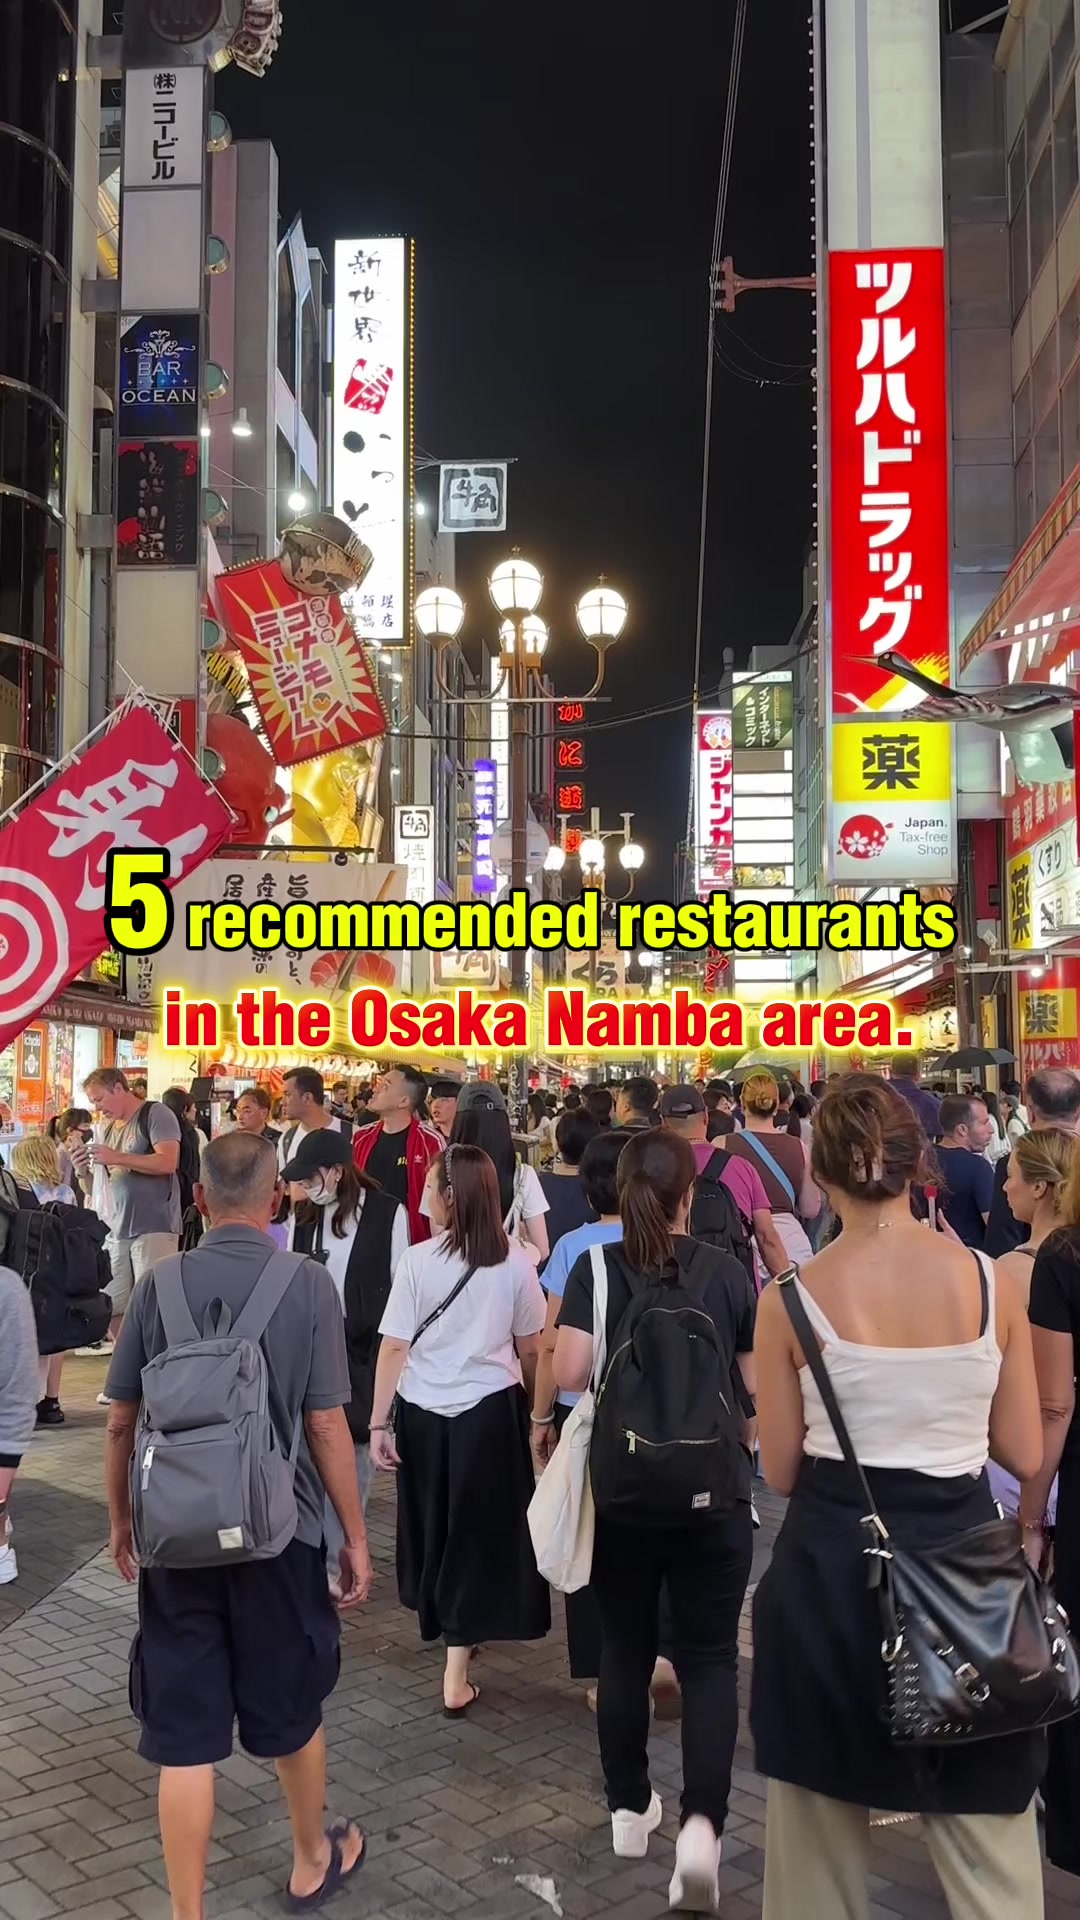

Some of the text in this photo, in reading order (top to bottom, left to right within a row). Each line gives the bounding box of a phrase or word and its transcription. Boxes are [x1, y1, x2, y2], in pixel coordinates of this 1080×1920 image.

[138, 361, 181, 376] BAR
[121, 389, 196, 403] OCEAN
[854, 262, 922, 656] ツルハドラッグ
[253, 611, 318, 735] ミュージアム
[759, 686, 770, 746] インターネット
[861, 733, 921, 790] 薬
[899, 830, 948, 843] Tax-free
[904, 817, 948, 829] Japan.
[917, 844, 948, 856] Shop
[1037, 840, 1062, 877] くすり
[1011, 862, 1031, 944] 薬
